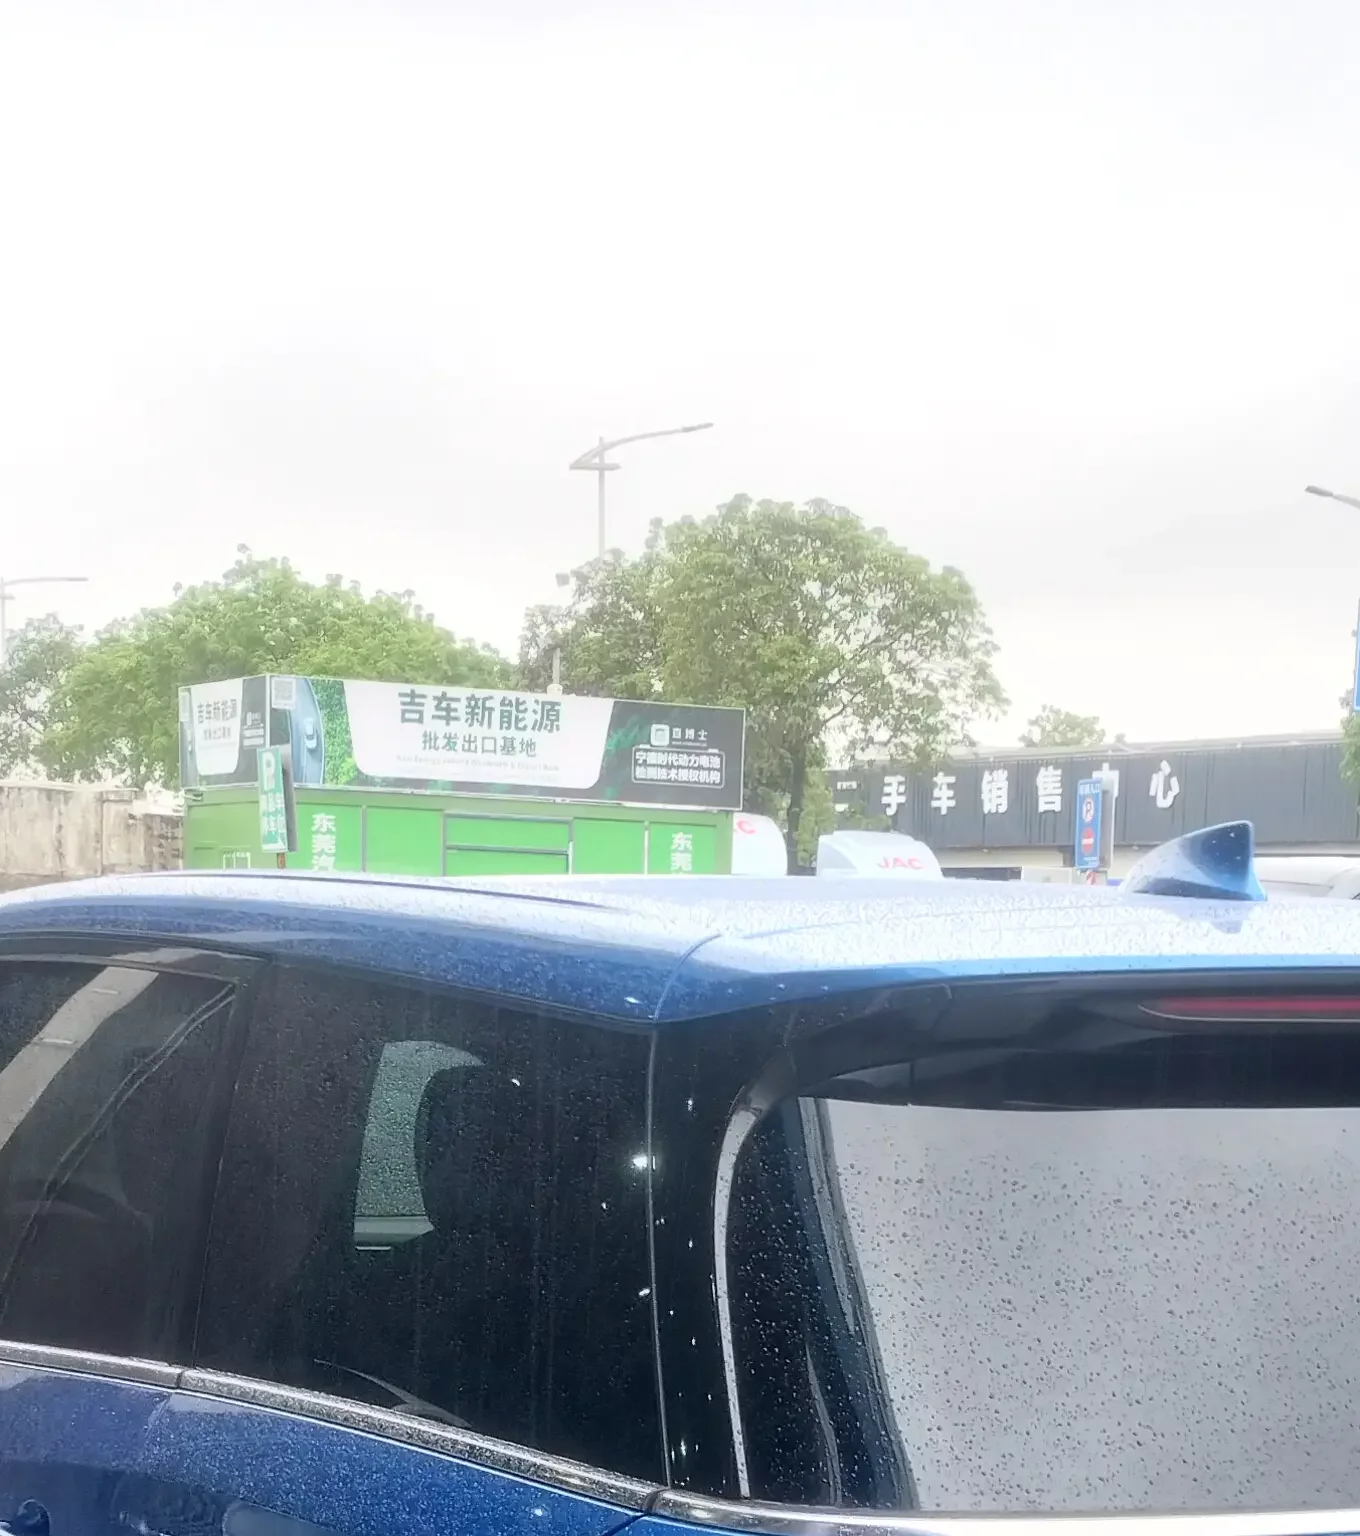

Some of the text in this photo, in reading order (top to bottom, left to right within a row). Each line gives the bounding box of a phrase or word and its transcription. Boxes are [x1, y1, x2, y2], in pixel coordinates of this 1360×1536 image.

[398, 689, 562, 733] 吉车新能源
[422, 730, 537, 757] 批发出口基地
[877, 857, 925, 871] JAC
